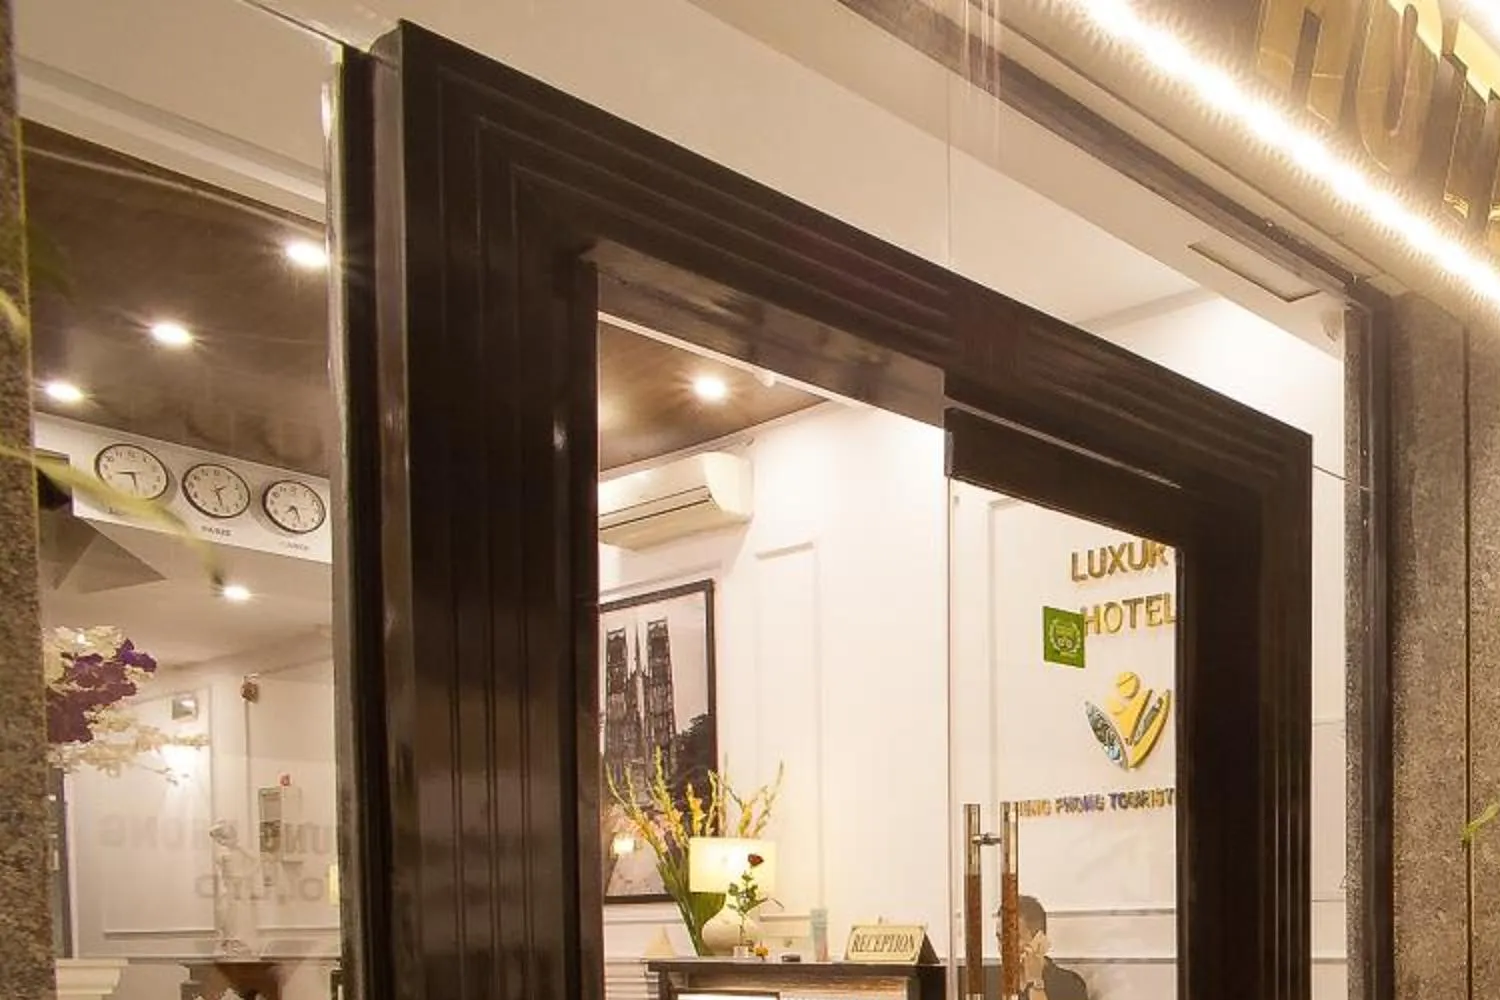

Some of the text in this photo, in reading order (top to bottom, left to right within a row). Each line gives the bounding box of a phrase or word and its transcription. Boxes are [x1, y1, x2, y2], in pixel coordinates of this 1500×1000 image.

[1072, 539, 1168, 581] LUXUR
[1081, 592, 1176, 636] HOTEL
[851, 933, 915, 953] RECEPTION
